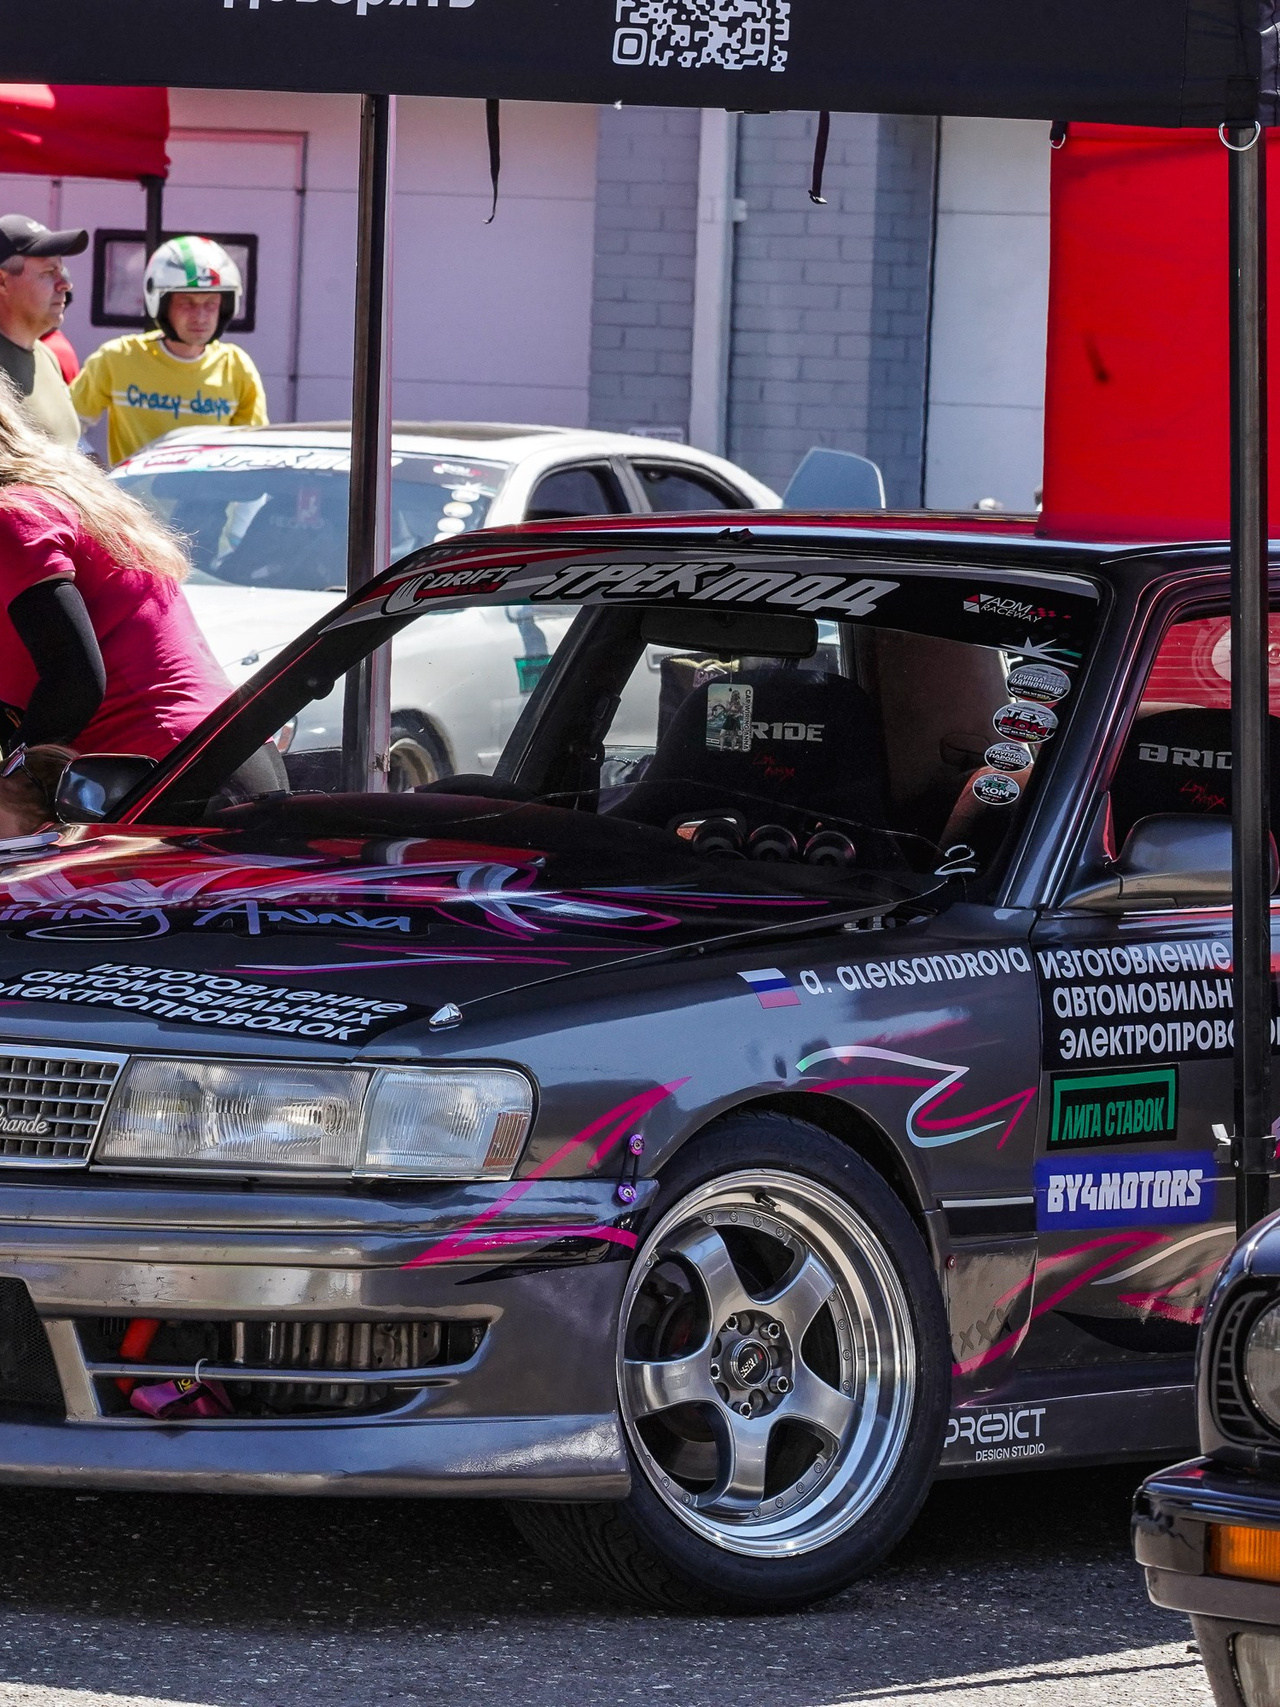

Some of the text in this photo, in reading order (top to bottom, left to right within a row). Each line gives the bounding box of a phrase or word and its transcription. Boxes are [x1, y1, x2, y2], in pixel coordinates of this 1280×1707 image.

[127, 384, 181, 420] Crazy
[423, 565, 523, 590] DRIFT
[980, 604, 1042, 623] RACEWAY
[985, 596, 1034, 613] ADM
[193, 899, 411, 935] Anna
[1061, 1096, 1166, 1141] ЛИГА СТАВОК
[1047, 1168, 1204, 1213] BY4MOTORS
[975, 1442, 1046, 1462] DESIGN STUDIO
